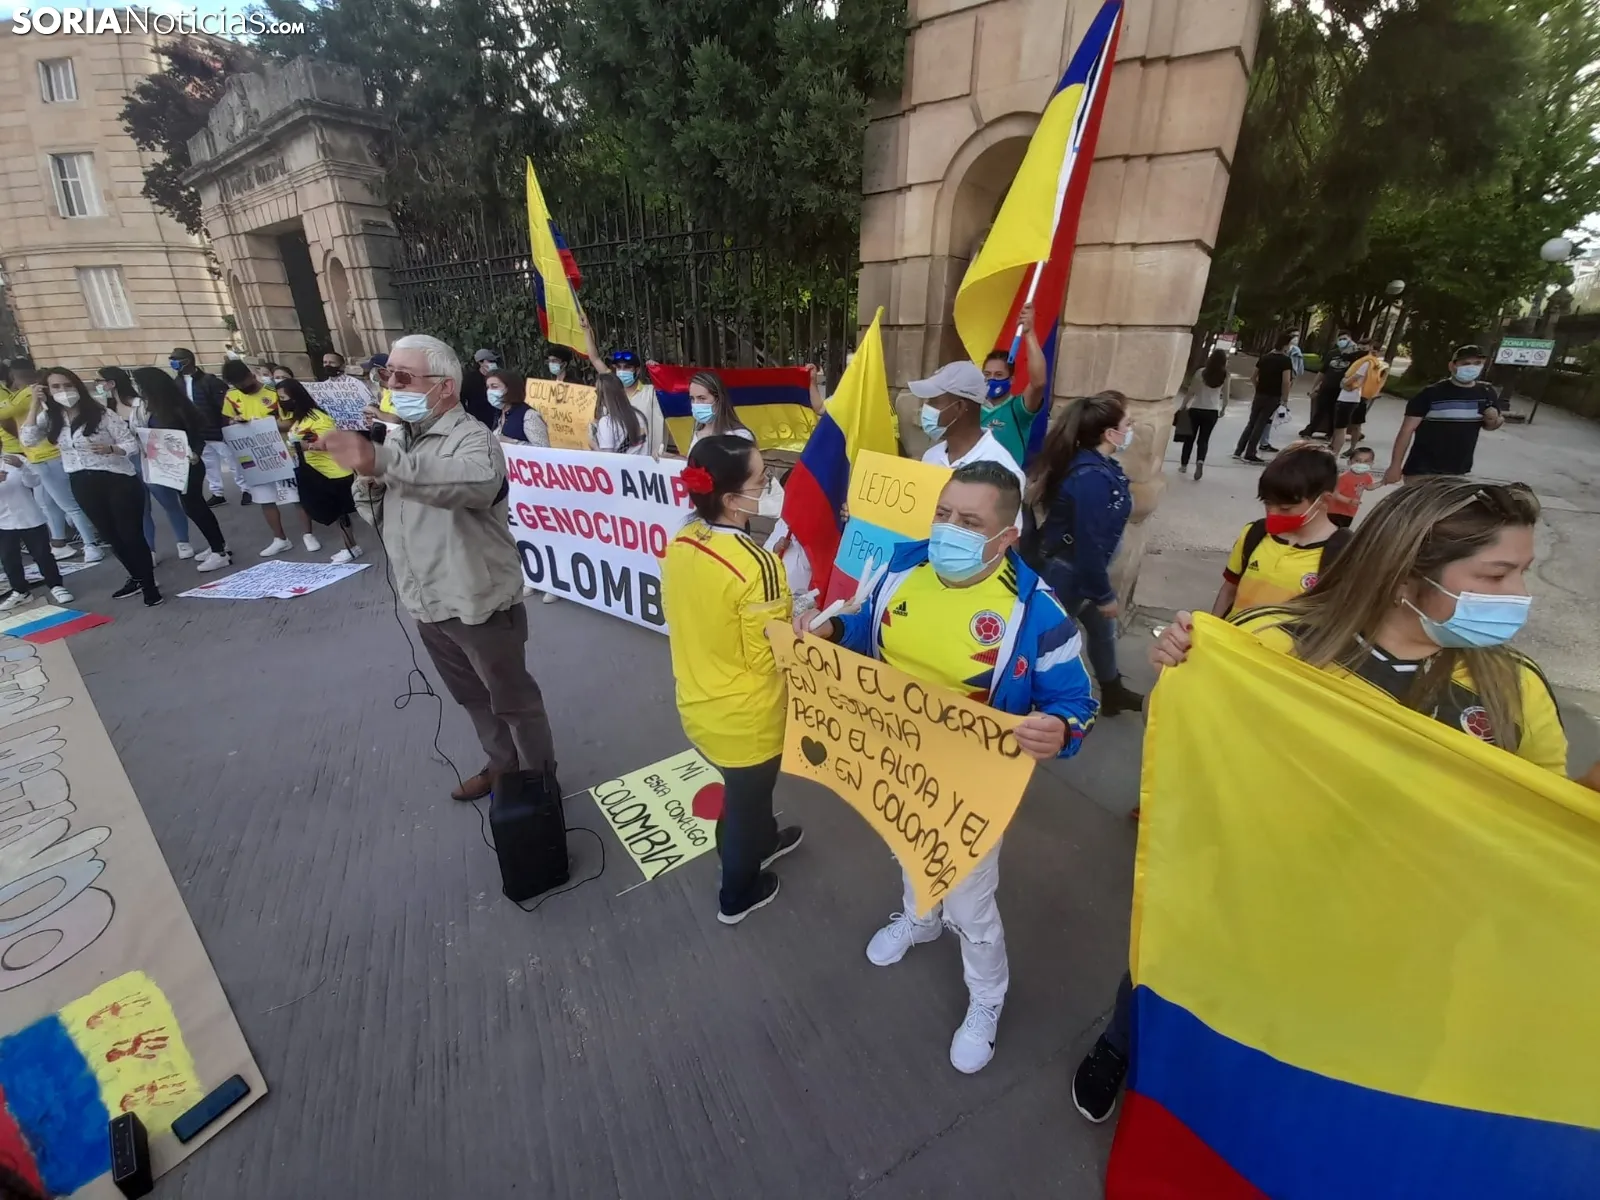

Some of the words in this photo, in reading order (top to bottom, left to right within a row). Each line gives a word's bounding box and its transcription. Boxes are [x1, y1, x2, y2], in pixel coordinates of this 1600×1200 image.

[508, 457, 614, 495] ACRANDO
[621, 469, 639, 499] A
[639, 470, 669, 505] MI
[858, 469, 916, 514] LEJOS
[516, 502, 667, 559] GENOCIDIO
[849, 530, 883, 572] PERO
[516, 540, 666, 626] OLOMB
[789, 663, 817, 695] EN
[793, 638, 841, 681] CON
[857, 665, 895, 702] EL
[903, 682, 1022, 759] CUERPO
[792, 697, 841, 742] PERO
[848, 729, 875, 760] EL
[880, 746, 939, 808] ALMA
[944, 791, 964, 827] Y
[960, 811, 990, 858] EL
[594, 778, 685, 880] COLOMBIA
[835, 757, 862, 790] EN
[872, 779, 957, 897] COLOMBIA
